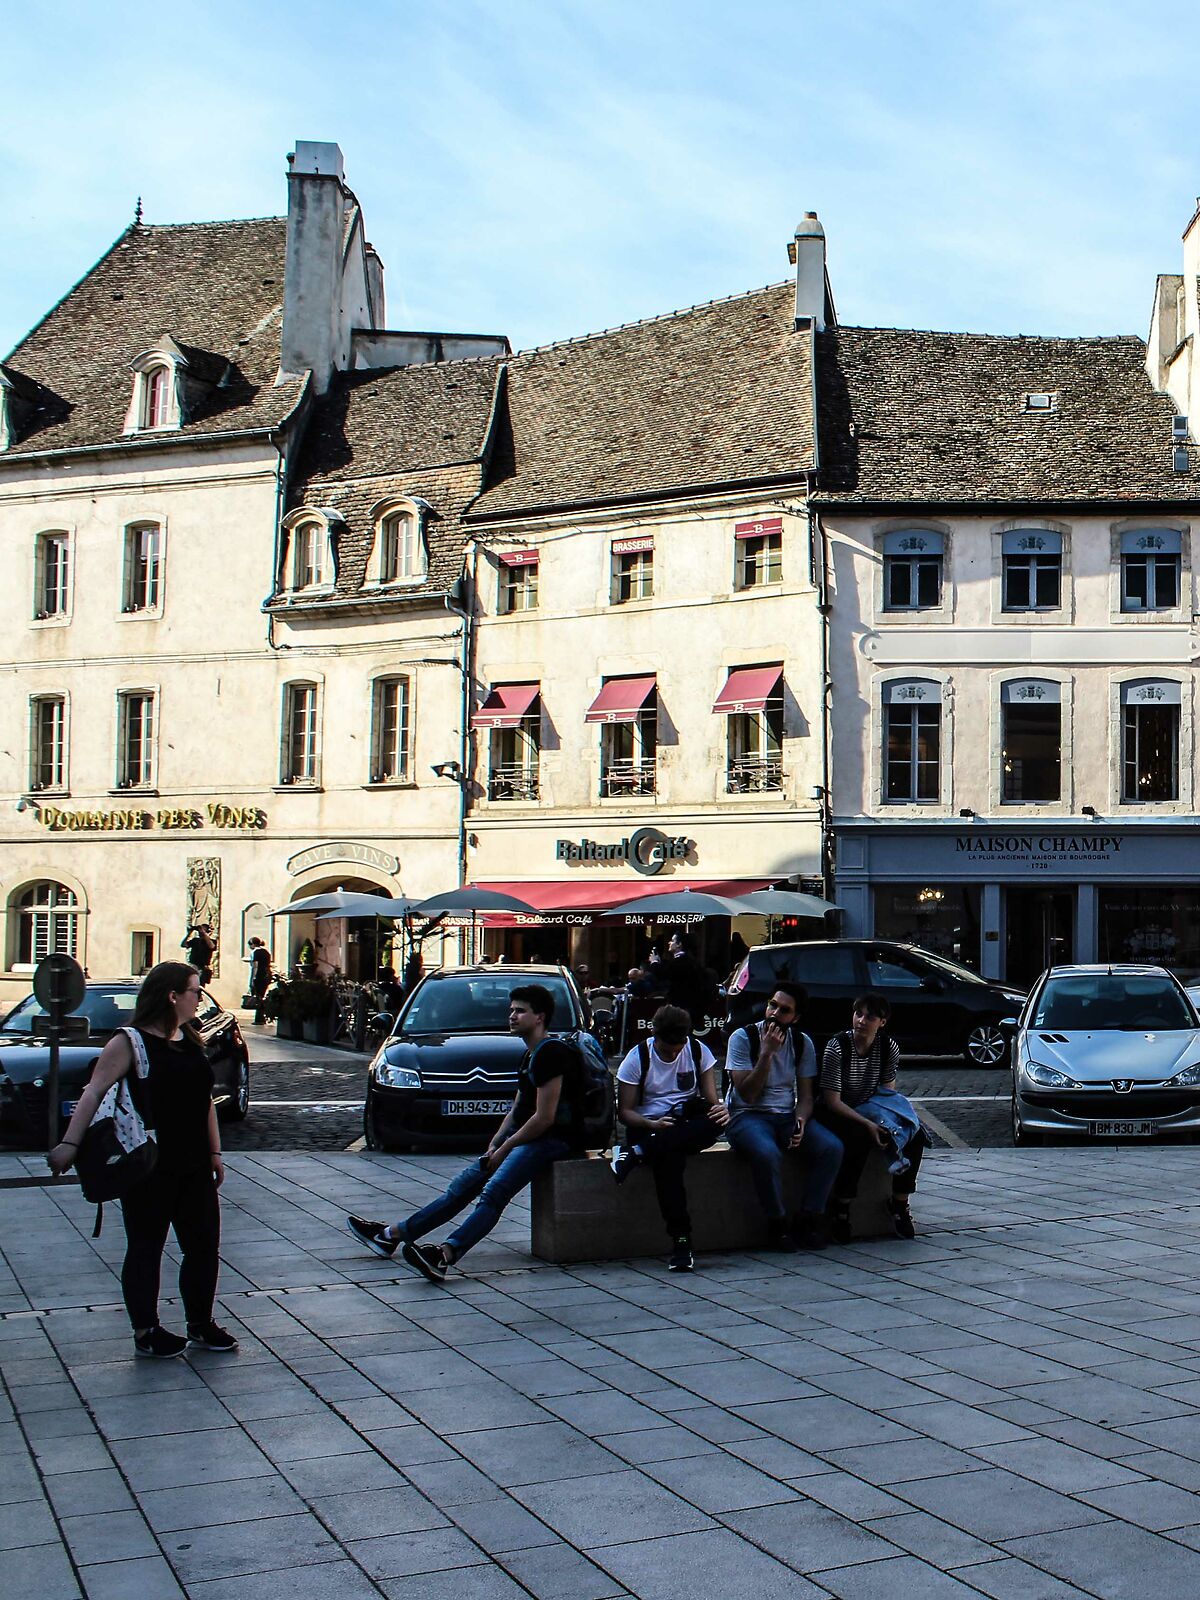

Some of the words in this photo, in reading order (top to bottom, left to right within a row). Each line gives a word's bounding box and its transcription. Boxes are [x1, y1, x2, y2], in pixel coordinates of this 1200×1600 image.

[612, 539, 655, 553] BRASSERIE
[40, 806, 145, 828] DOMAINE
[156, 810, 195, 826] DES
[206, 802, 258, 825] VINS
[556, 837, 630, 861] Baltard
[630, 827, 688, 875] Café
[956, 837, 1032, 852] MAISON
[1038, 837, 1124, 852] CHAMPY
[293, 847, 333, 869] CAVE
[351, 845, 391, 868] VINS
